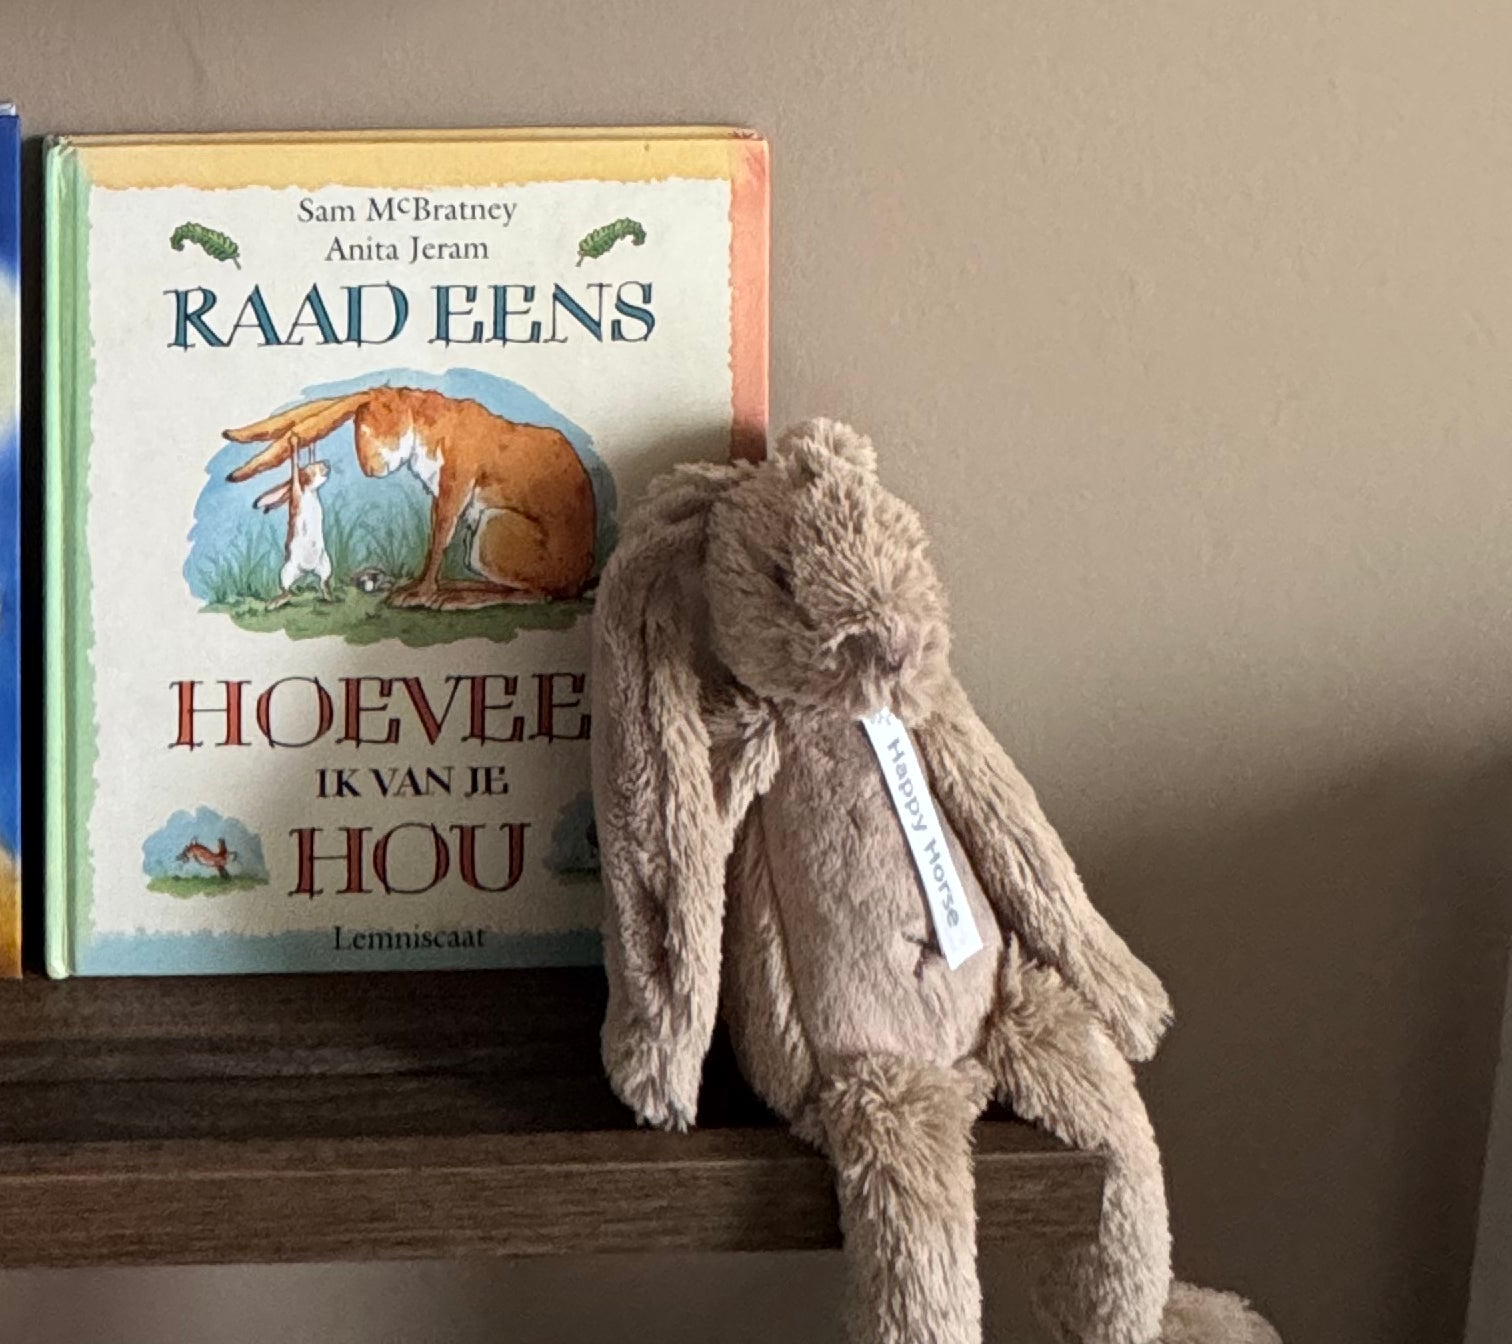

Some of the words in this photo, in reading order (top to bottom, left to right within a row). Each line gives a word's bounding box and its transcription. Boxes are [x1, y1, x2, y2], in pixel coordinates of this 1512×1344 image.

[297, 197, 356, 223] Sam
[366, 196, 517, 228] McBratney
[324, 236, 400, 262] Anita
[409, 235, 489, 265] Jeram
[163, 278, 409, 352] RAAD
[427, 280, 656, 349] EENS
[168, 671, 590, 752] HOEVEE
[317, 768, 361, 799] IK
[370, 766, 454, 798] VAN
[464, 766, 509, 798] JE
[288, 819, 533, 900] HOU
[886, 738, 928, 832] Happy
[923, 838, 960, 928] Horse
[332, 923, 487, 954] Lemniscaat
